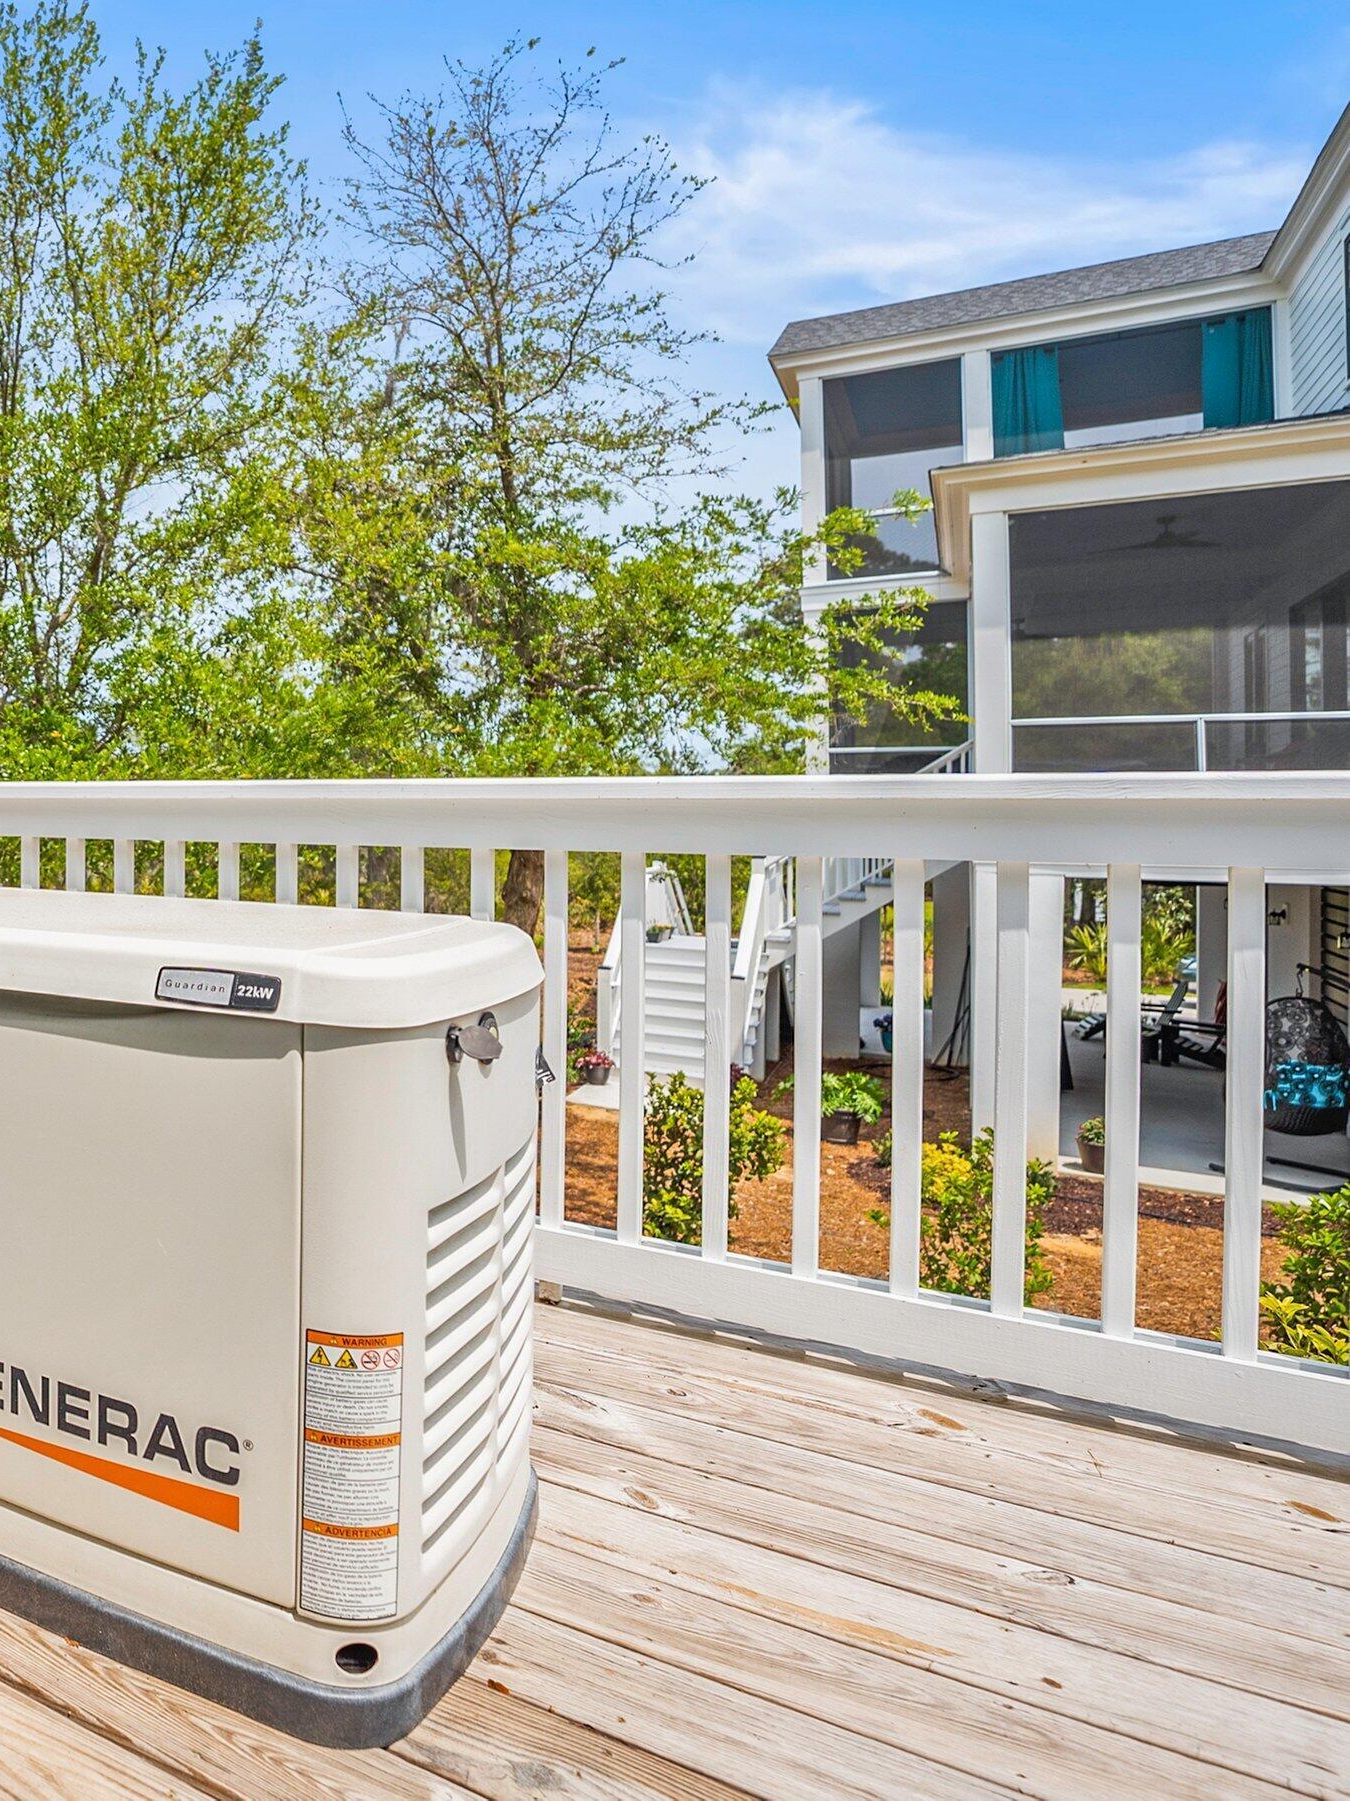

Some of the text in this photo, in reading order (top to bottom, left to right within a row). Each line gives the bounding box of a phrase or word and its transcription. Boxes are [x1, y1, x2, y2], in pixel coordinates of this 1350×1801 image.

[165, 979, 225, 993] Guardian
[237, 985, 274, 999] 22kW
[341, 1337, 388, 1347] WARNING
[320, 1434, 399, 1447] AVERTISSEMENT
[325, 1527, 392, 1538] ADVERTENCIA
